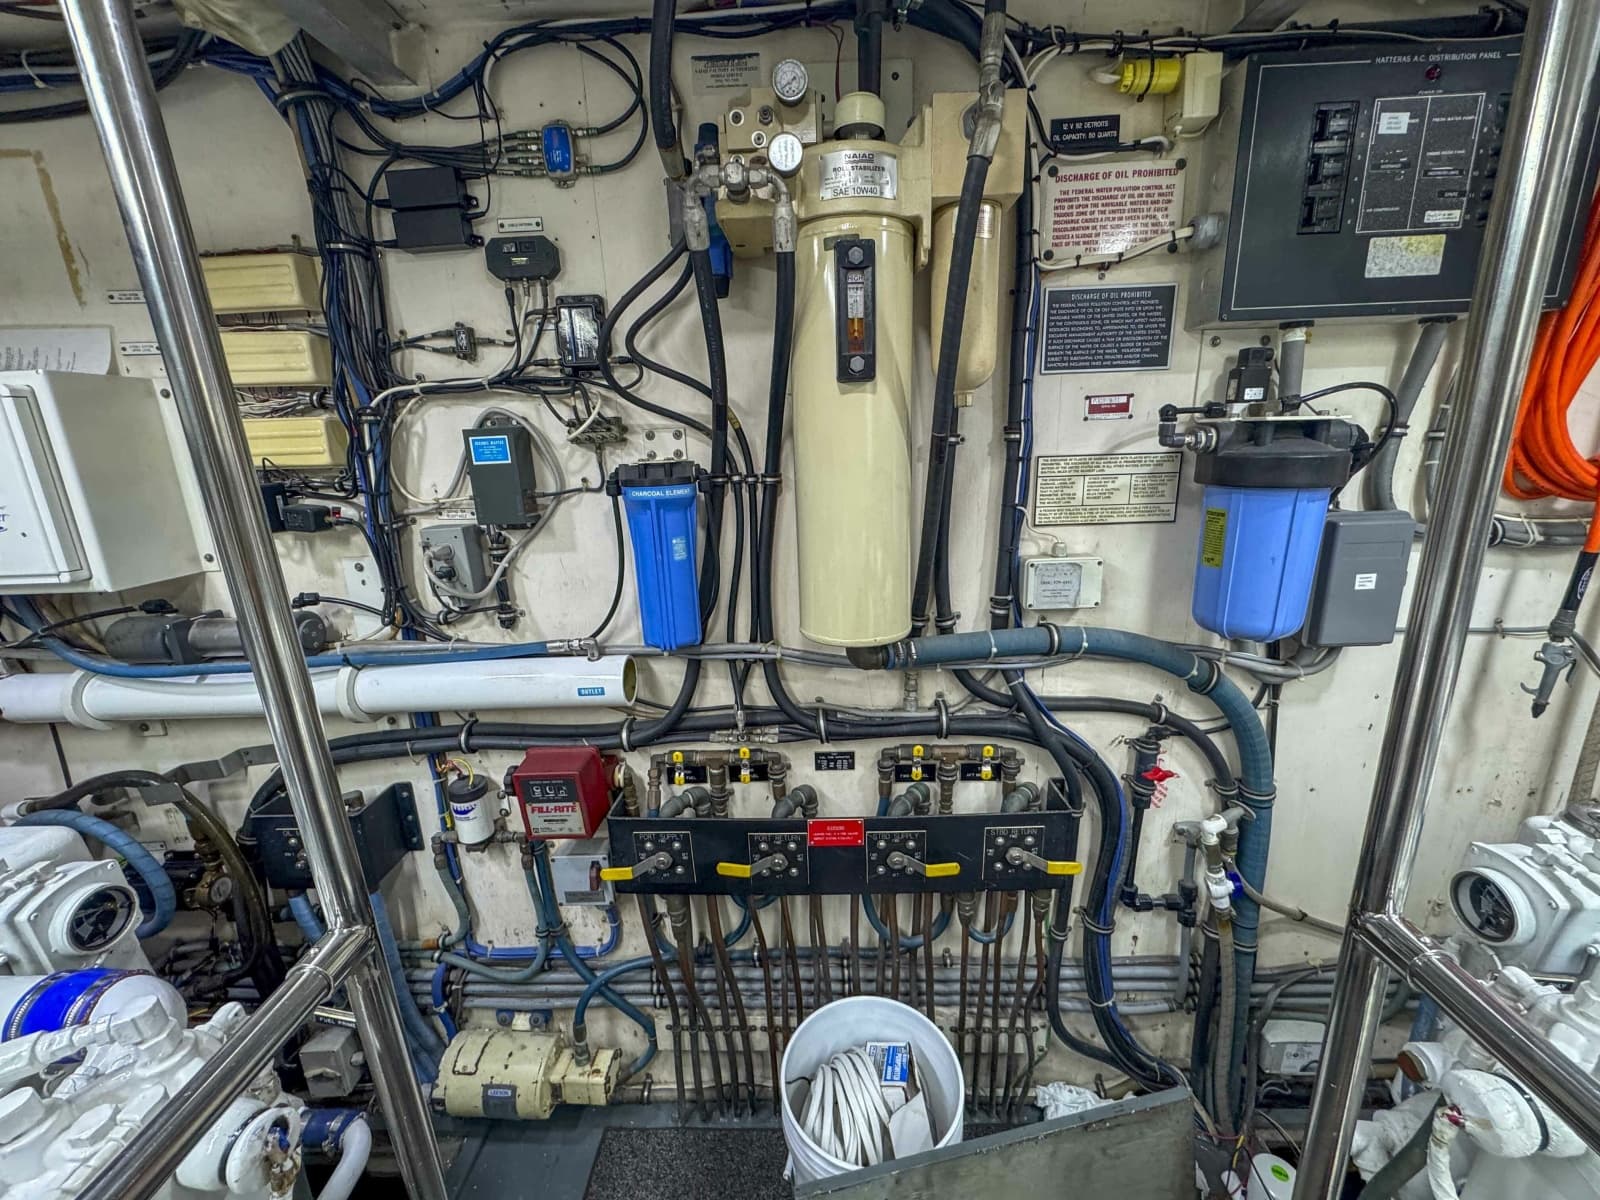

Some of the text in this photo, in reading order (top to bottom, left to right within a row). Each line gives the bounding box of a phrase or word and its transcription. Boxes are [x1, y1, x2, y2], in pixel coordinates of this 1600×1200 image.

[1056, 172, 1100, 183] DISCHARGE
[1102, 171, 1112, 180] OF
[1132, 168, 1179, 178] PROHIBITED
[832, 188, 849, 197] SAE
